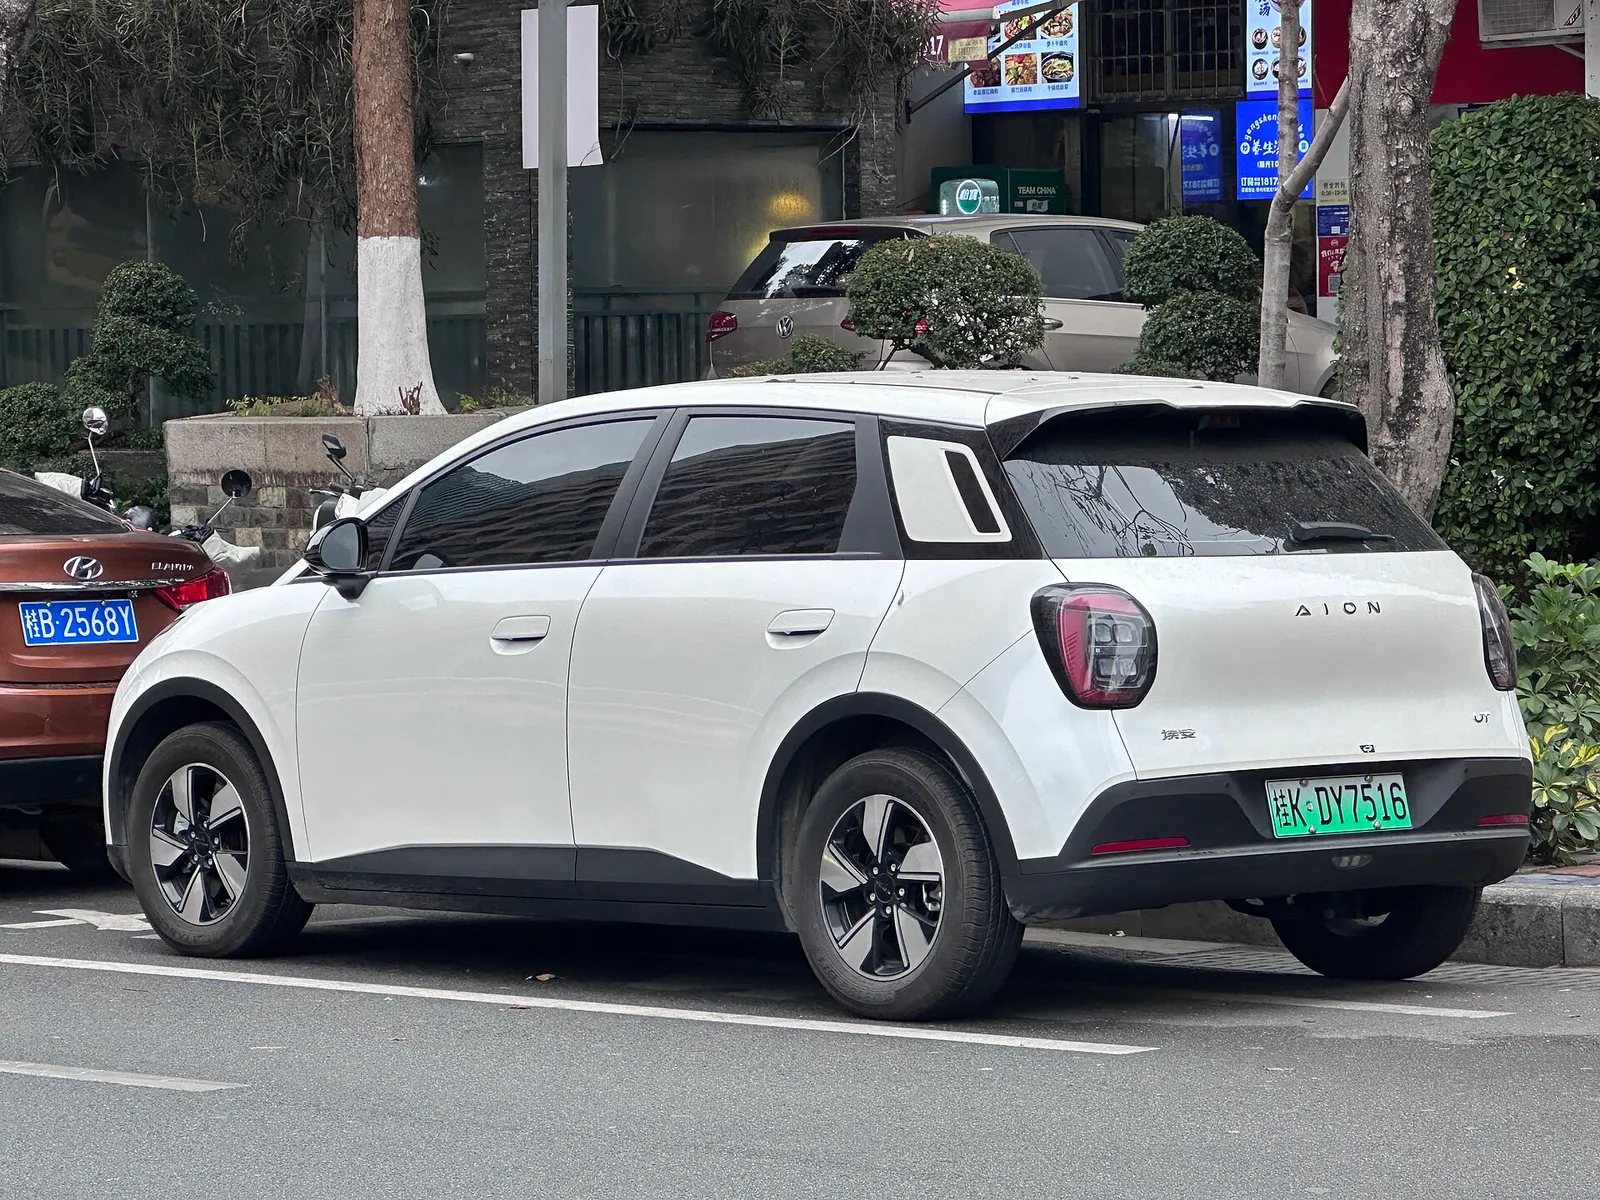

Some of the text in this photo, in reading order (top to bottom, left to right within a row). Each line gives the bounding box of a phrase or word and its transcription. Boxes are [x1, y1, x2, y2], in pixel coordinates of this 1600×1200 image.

[1018, 186, 1056, 195] TEAM CHINA
[1295, 601, 1382, 617] AION
